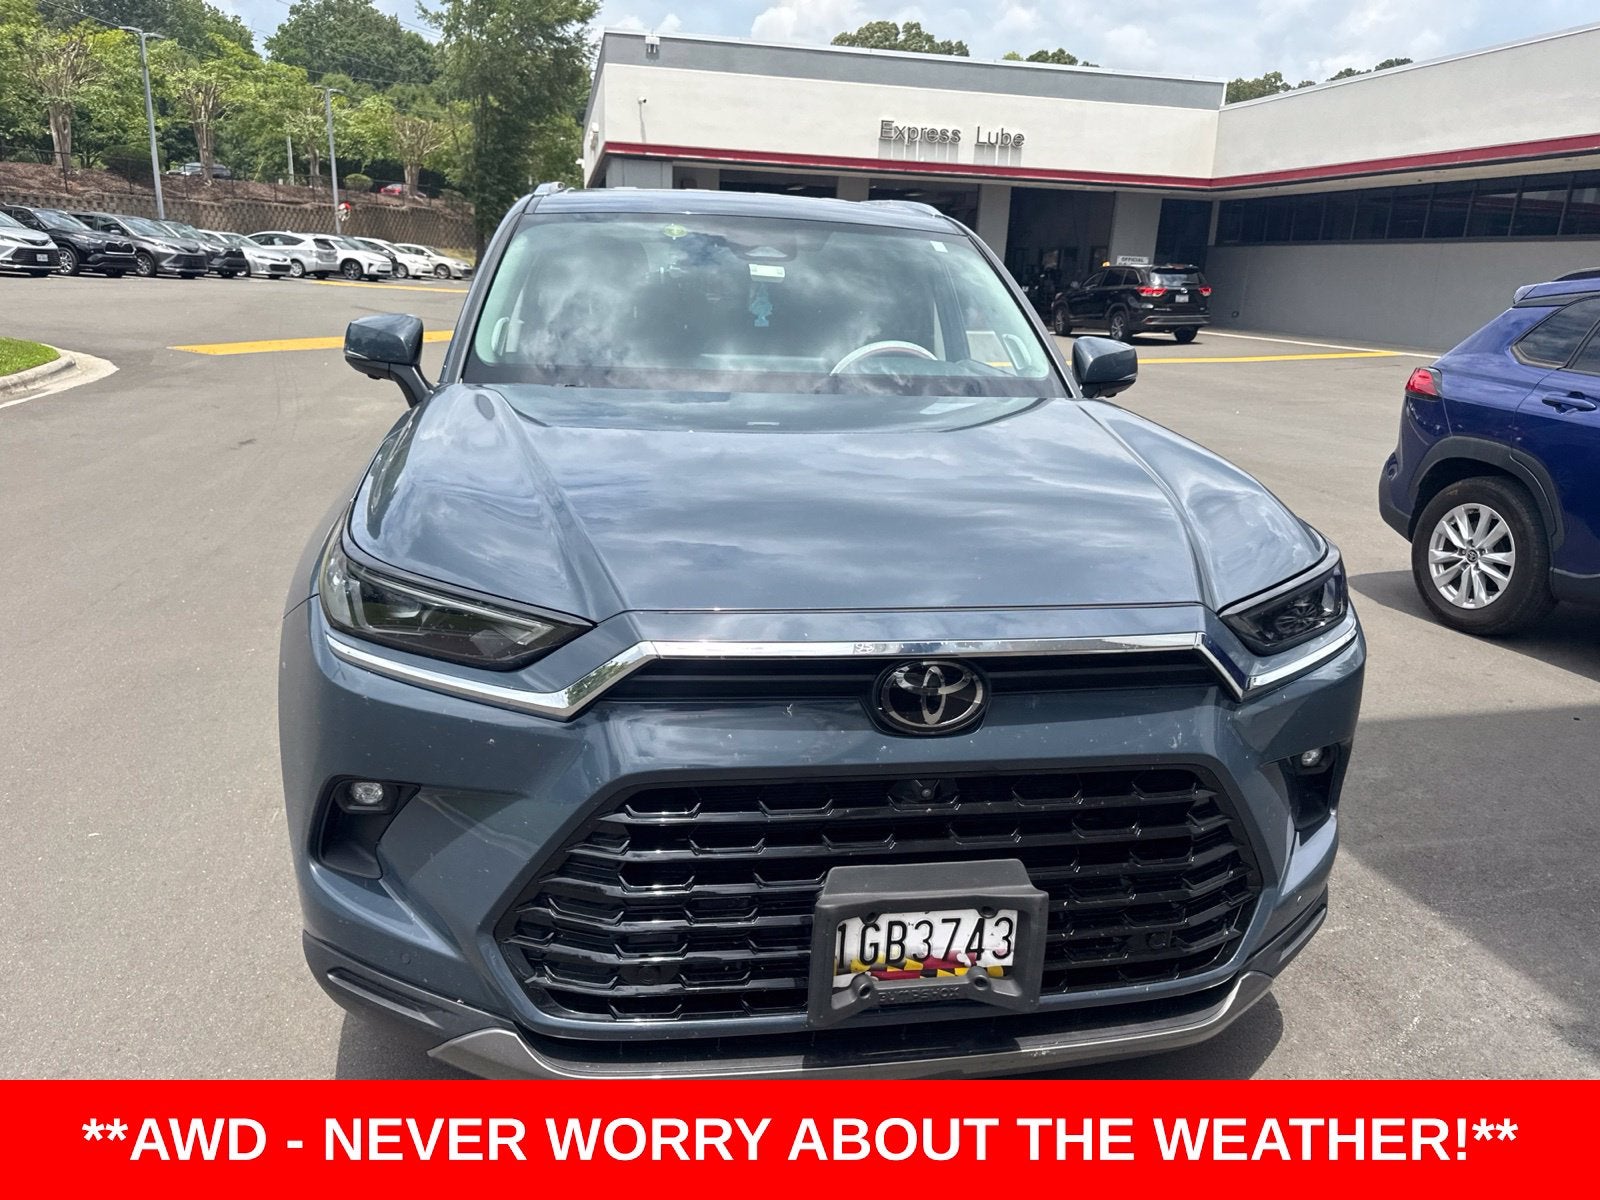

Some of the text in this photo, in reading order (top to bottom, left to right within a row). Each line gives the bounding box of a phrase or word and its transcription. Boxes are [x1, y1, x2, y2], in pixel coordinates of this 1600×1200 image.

[880, 119, 1025, 147] Express Lube
[836, 916, 1014, 970] 1GB3743
